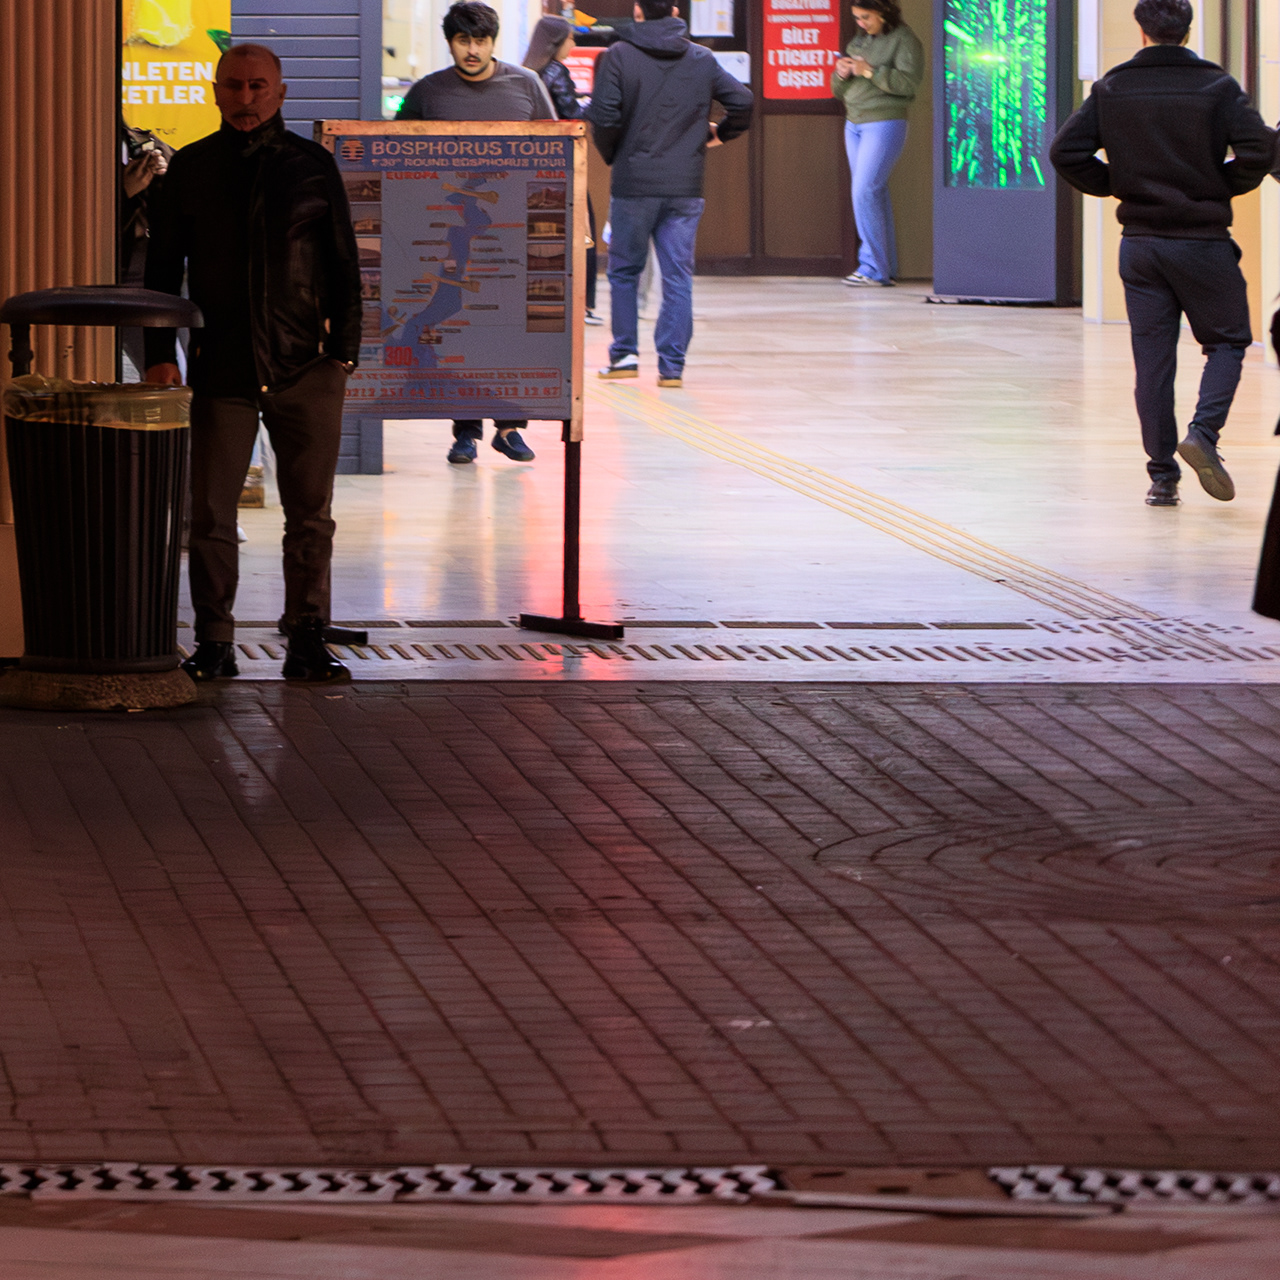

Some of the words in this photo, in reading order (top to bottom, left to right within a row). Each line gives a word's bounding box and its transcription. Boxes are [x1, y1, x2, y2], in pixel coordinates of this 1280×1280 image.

[781, 26, 820, 45] BİLET
[777, 67, 825, 89] GİŞESİ
[371, 141, 503, 157] BOSPHORUS
[506, 141, 564, 156] TOUR
[385, 171, 441, 181] EUROPA
